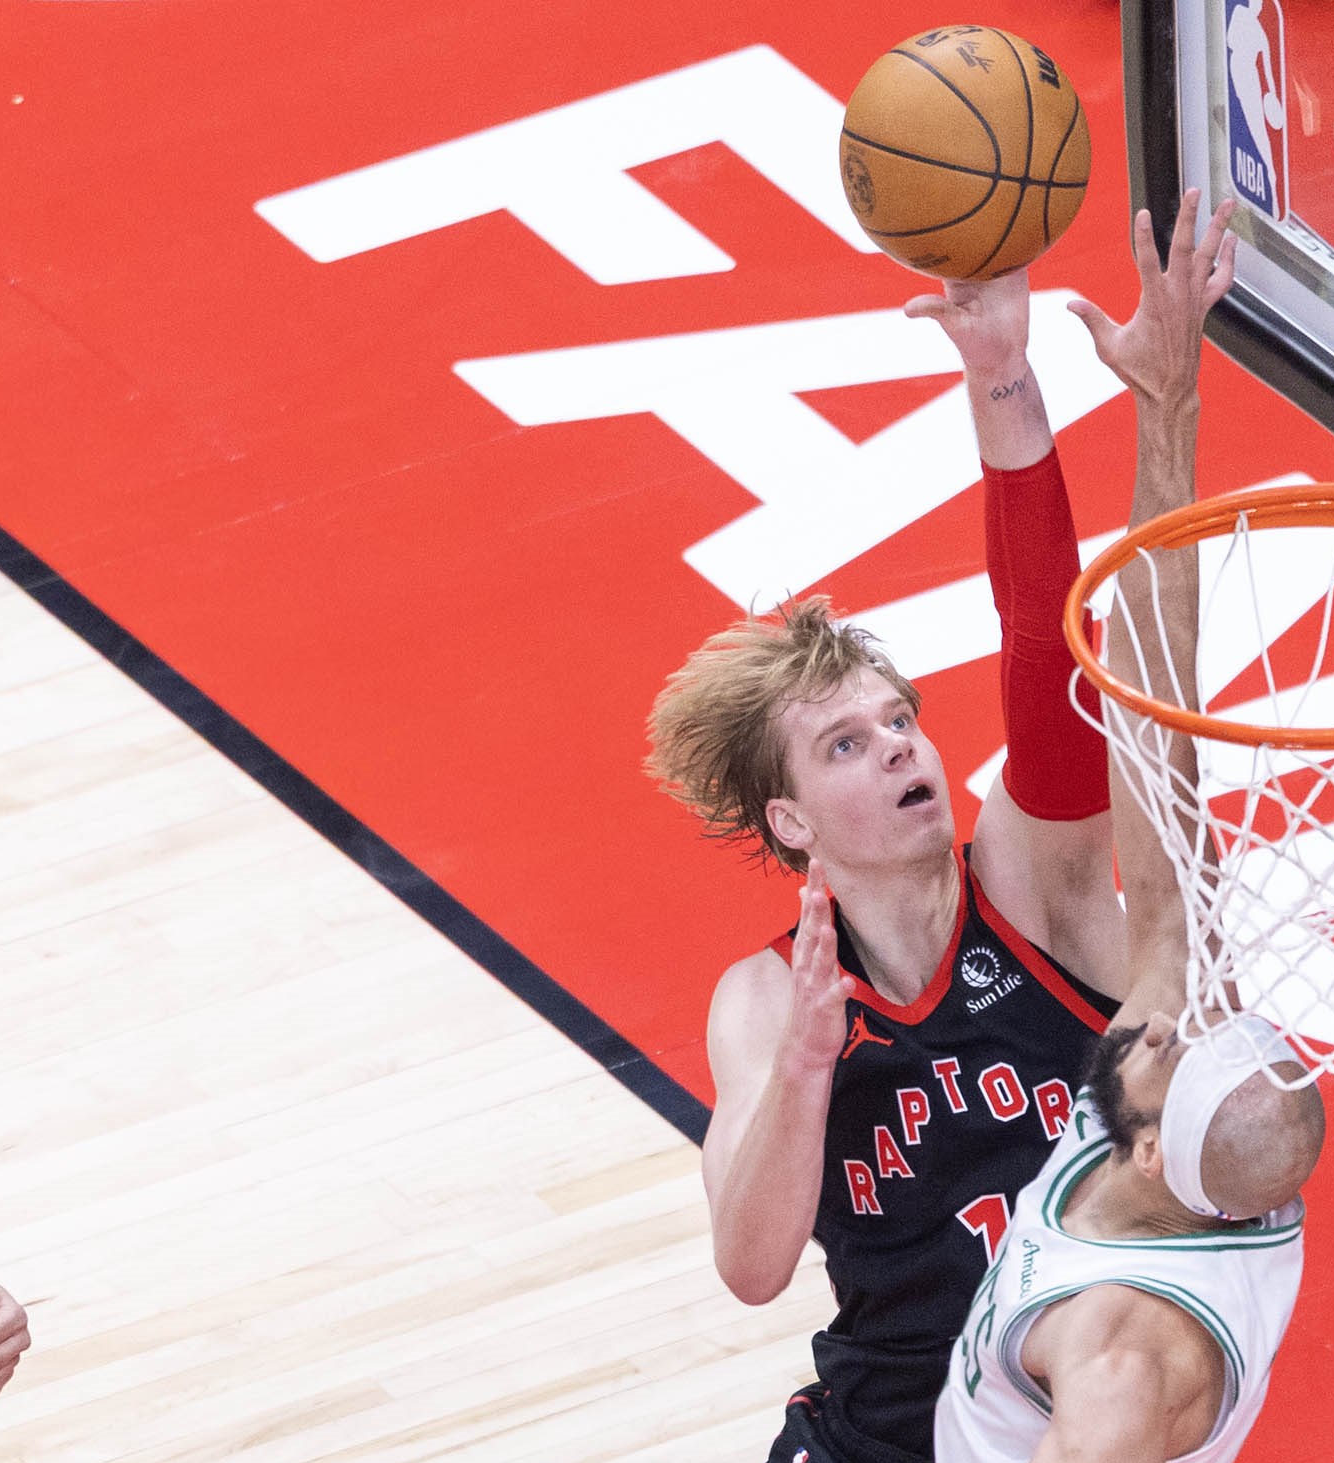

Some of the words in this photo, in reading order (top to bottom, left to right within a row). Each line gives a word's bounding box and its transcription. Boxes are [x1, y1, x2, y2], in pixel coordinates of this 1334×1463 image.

[1235, 146, 1267, 202] NBA
[966, 992, 997, 1014] Sun
[994, 973, 1023, 997] Life
